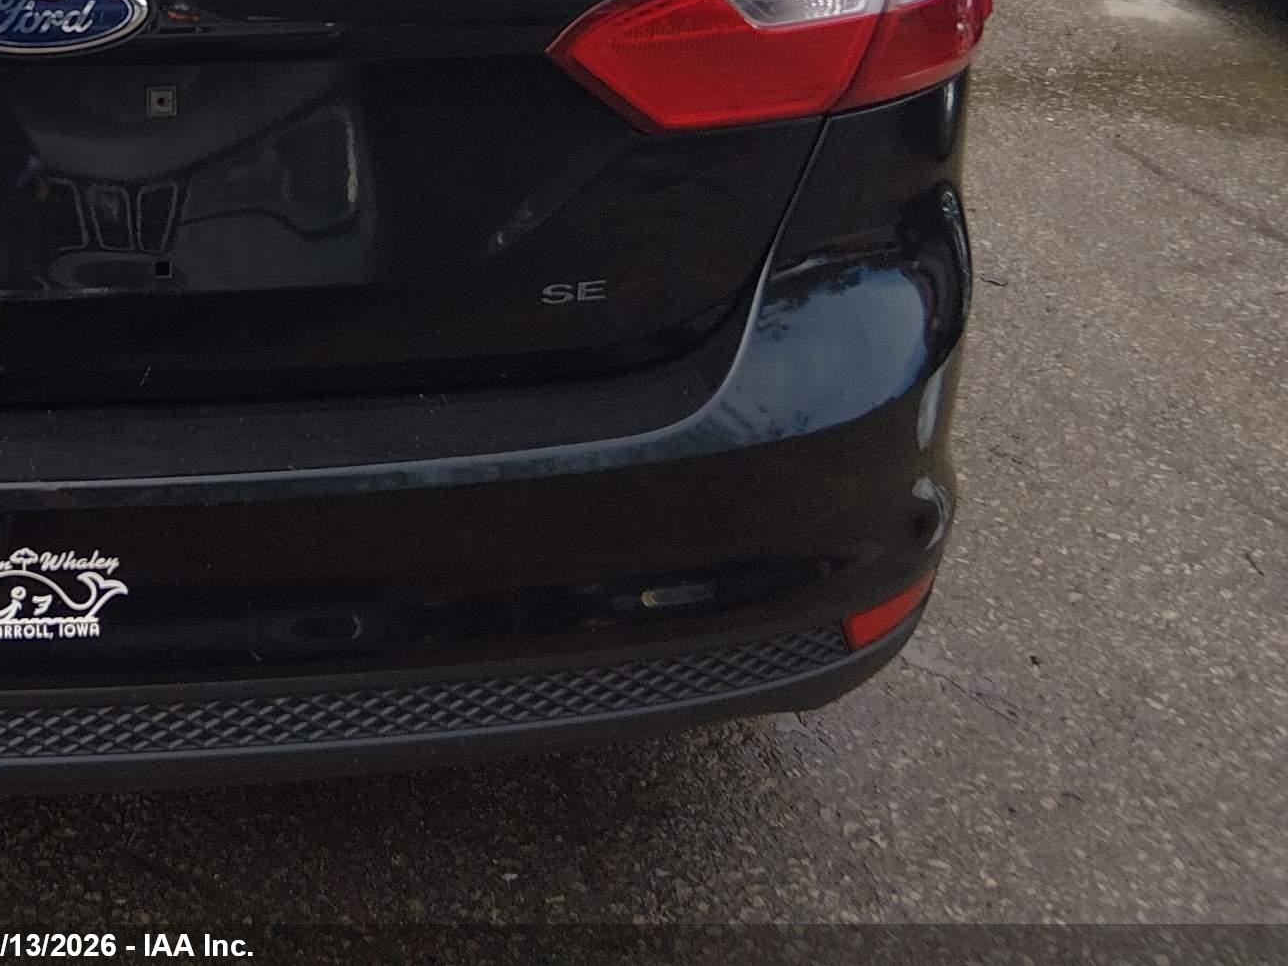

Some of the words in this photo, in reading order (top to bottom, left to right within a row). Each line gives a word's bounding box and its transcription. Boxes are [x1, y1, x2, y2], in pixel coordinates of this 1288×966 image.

[541, 280, 607, 303] SE
[39, 549, 120, 575] Whaley
[58, 622, 100, 637] IOWA
